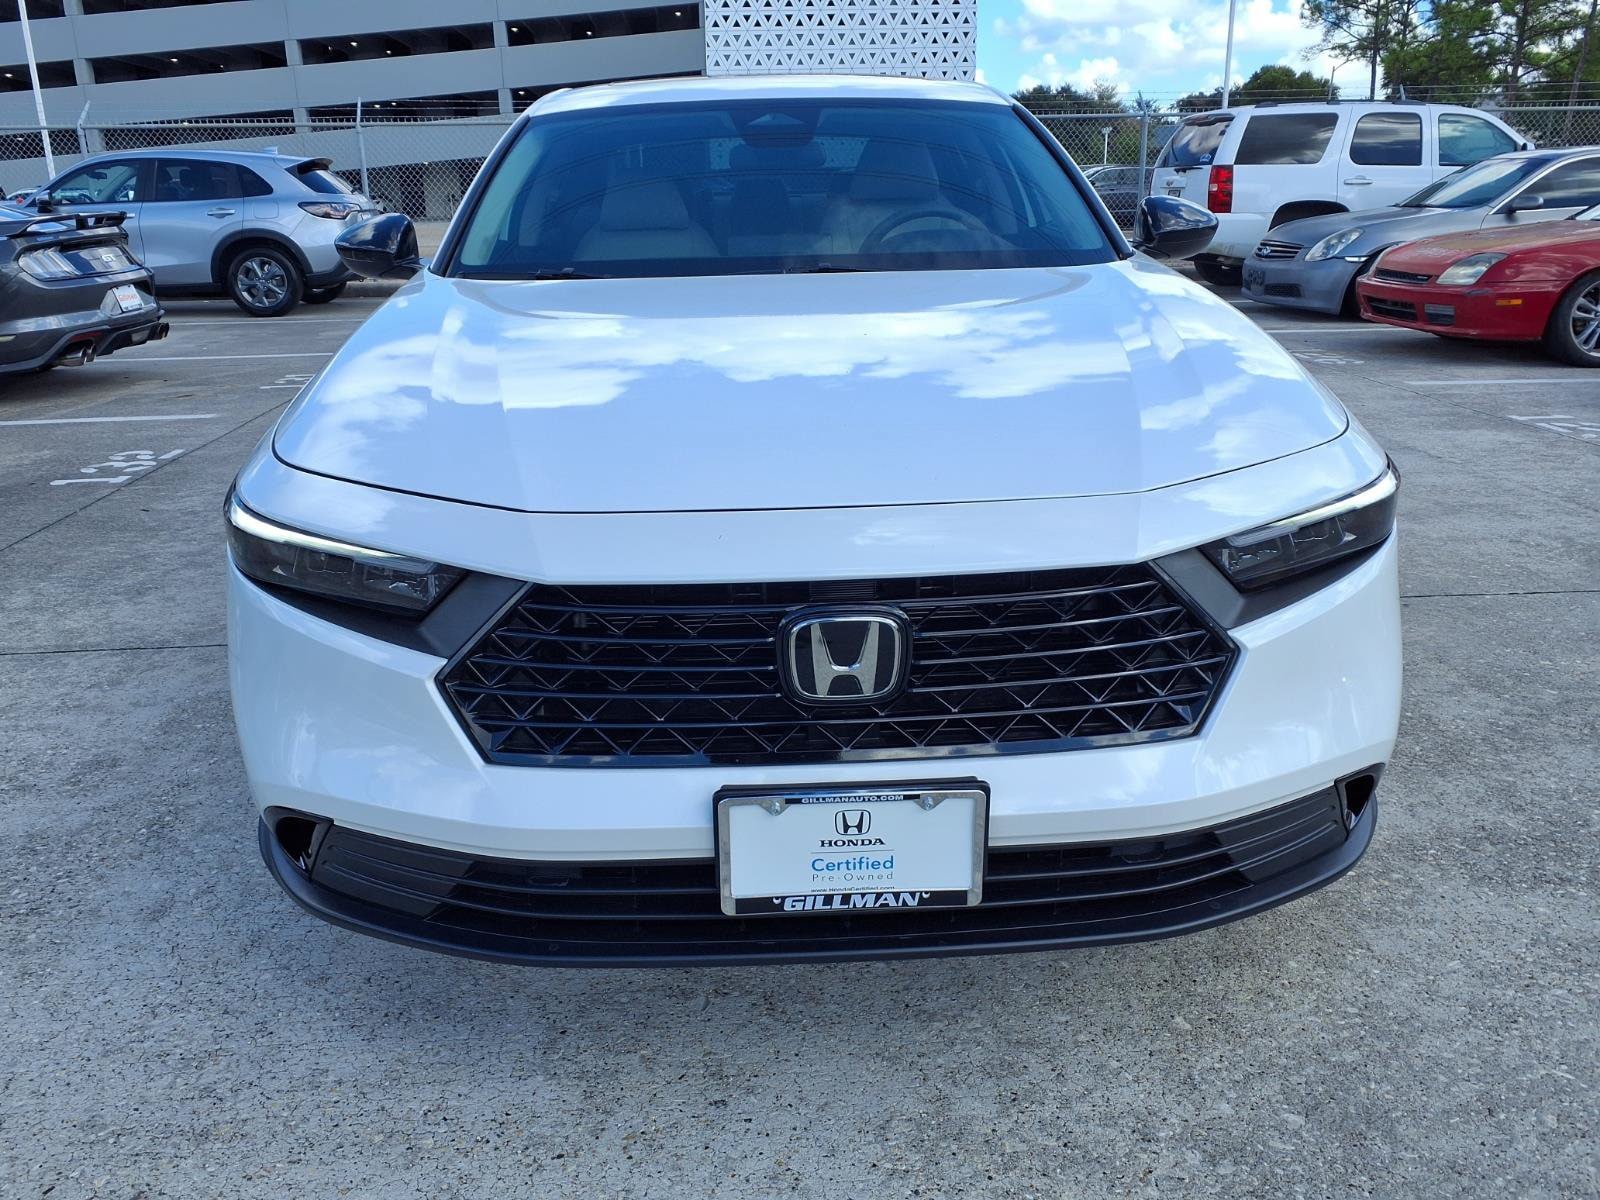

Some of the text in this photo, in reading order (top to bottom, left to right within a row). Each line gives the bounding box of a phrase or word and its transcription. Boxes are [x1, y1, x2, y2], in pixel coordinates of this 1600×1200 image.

[801, 794, 904, 804] GILLMANAUTO.COM
[819, 837, 886, 848] HONDA
[811, 855, 894, 873] Certified
[812, 872, 893, 882] Pre-Owned
[783, 891, 921, 911] GILLMAN
